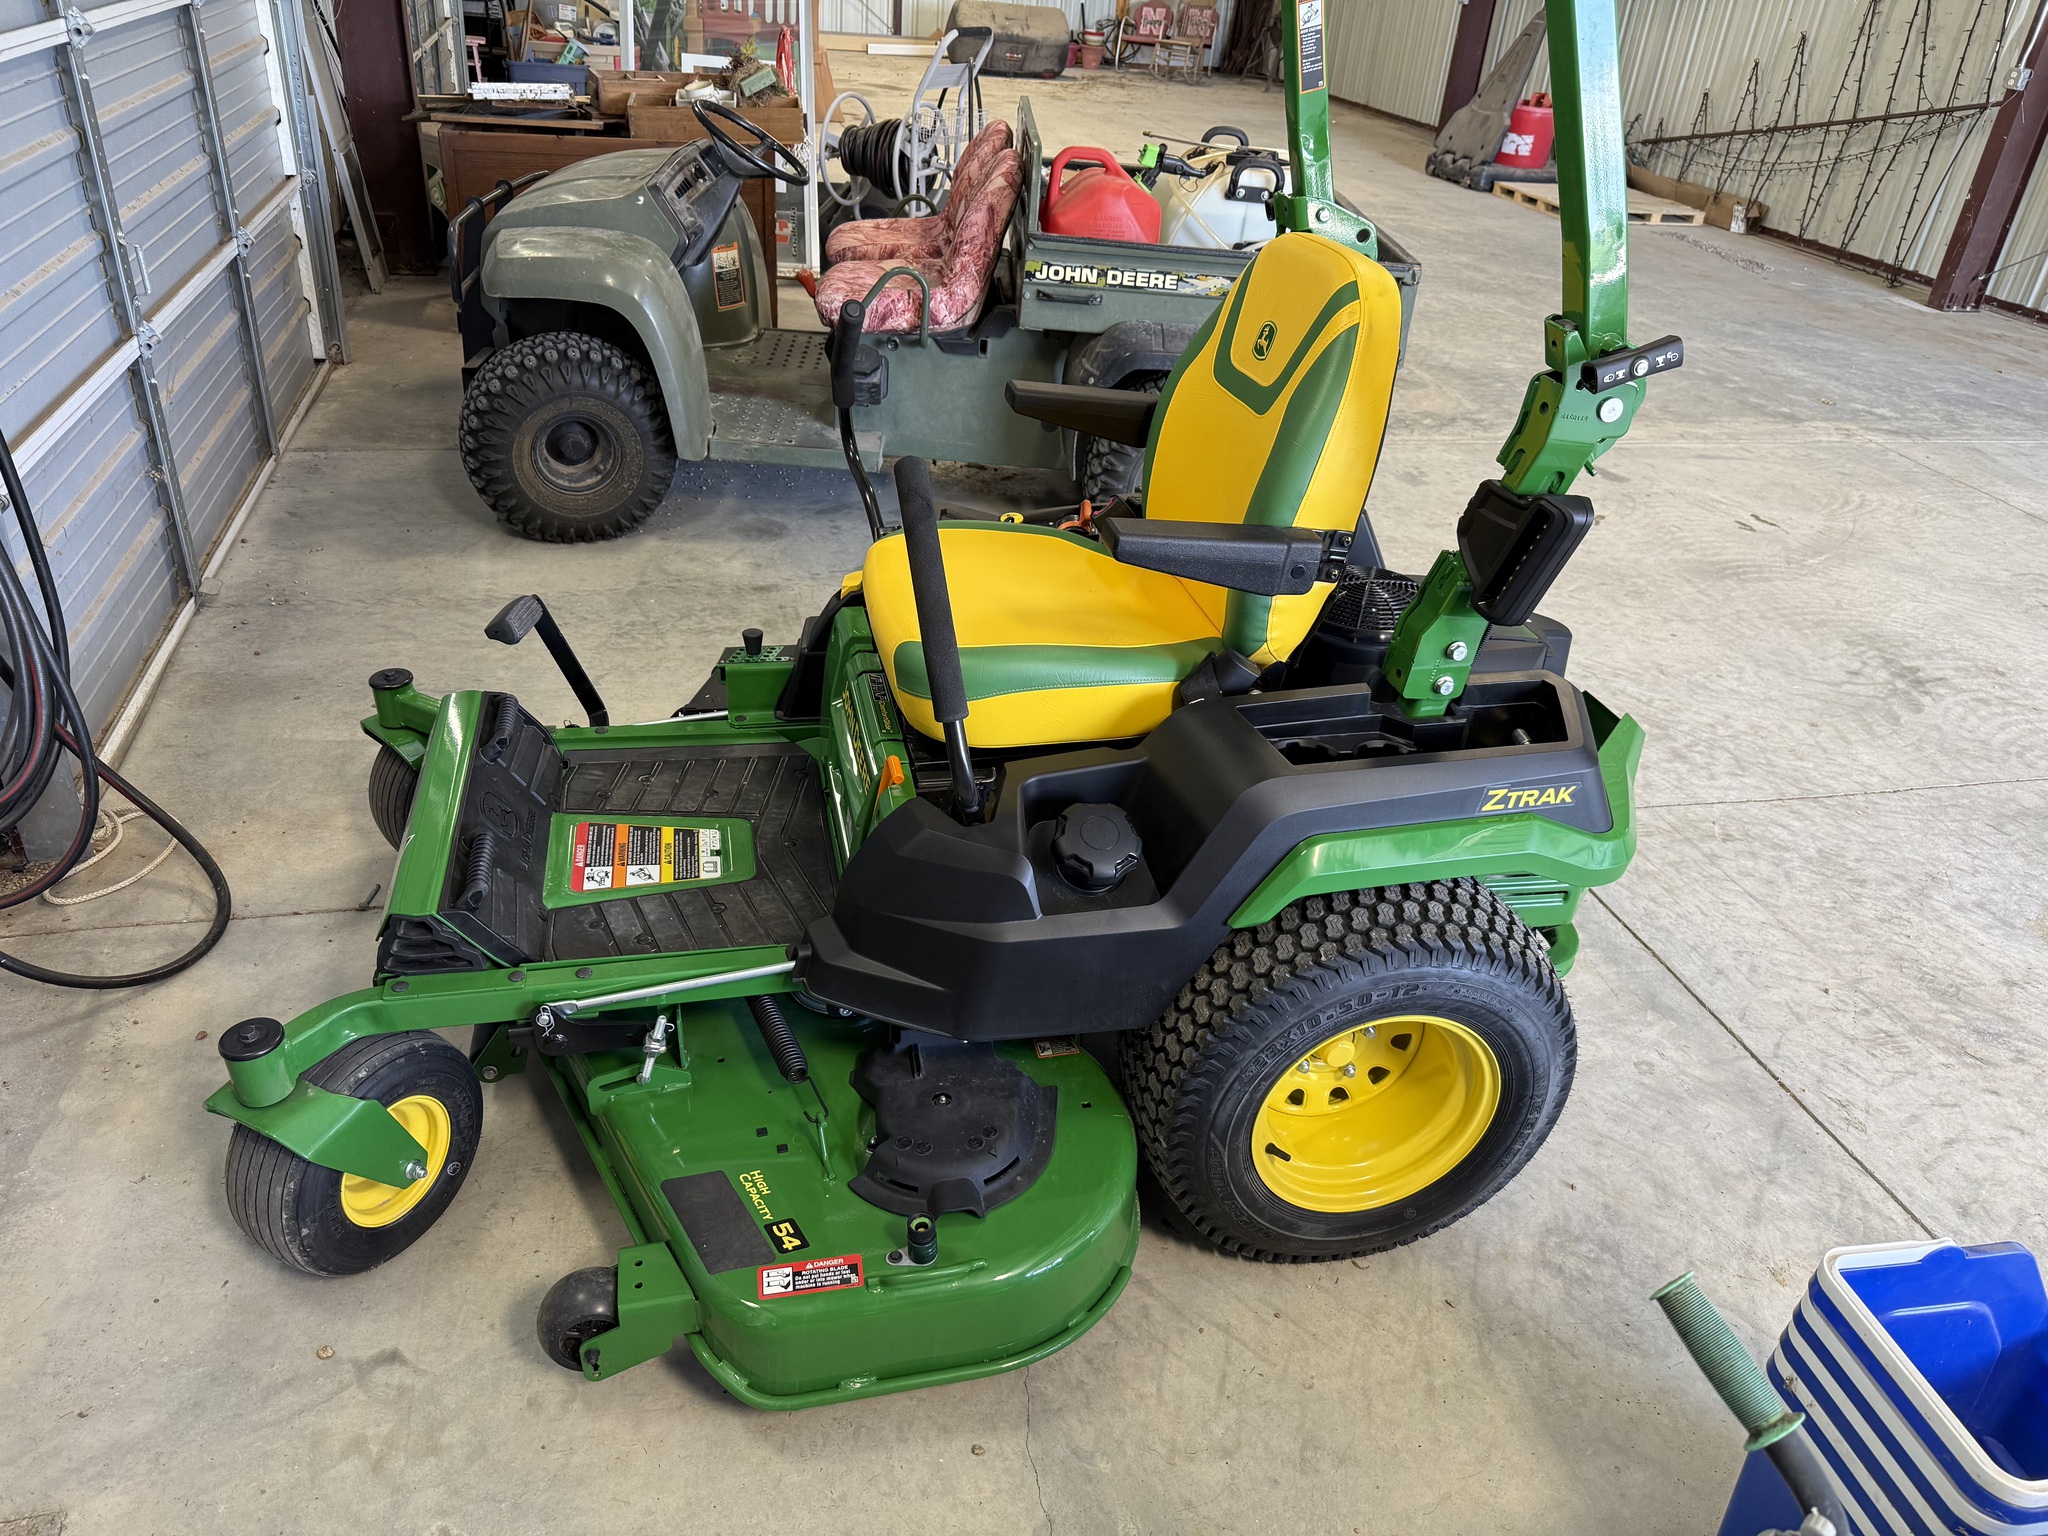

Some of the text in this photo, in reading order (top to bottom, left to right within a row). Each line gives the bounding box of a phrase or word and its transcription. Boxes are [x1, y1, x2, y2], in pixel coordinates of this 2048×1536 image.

[1035, 264, 1179, 290] JOHN DEERE
[1481, 786, 1577, 811] ZTRAK
[577, 844, 586, 862] DANGER
[618, 842, 626, 861] WARNING
[664, 842, 673, 860] CAUTION
[1499, 1097, 1547, 1168] KENDA
[750, 1170, 772, 1195] HIGH
[739, 1173, 774, 1220] CAPACITY
[772, 1222, 802, 1251] 54
[801, 1267, 829, 1275] ROTATING
[813, 1258, 844, 1268] DANGER
